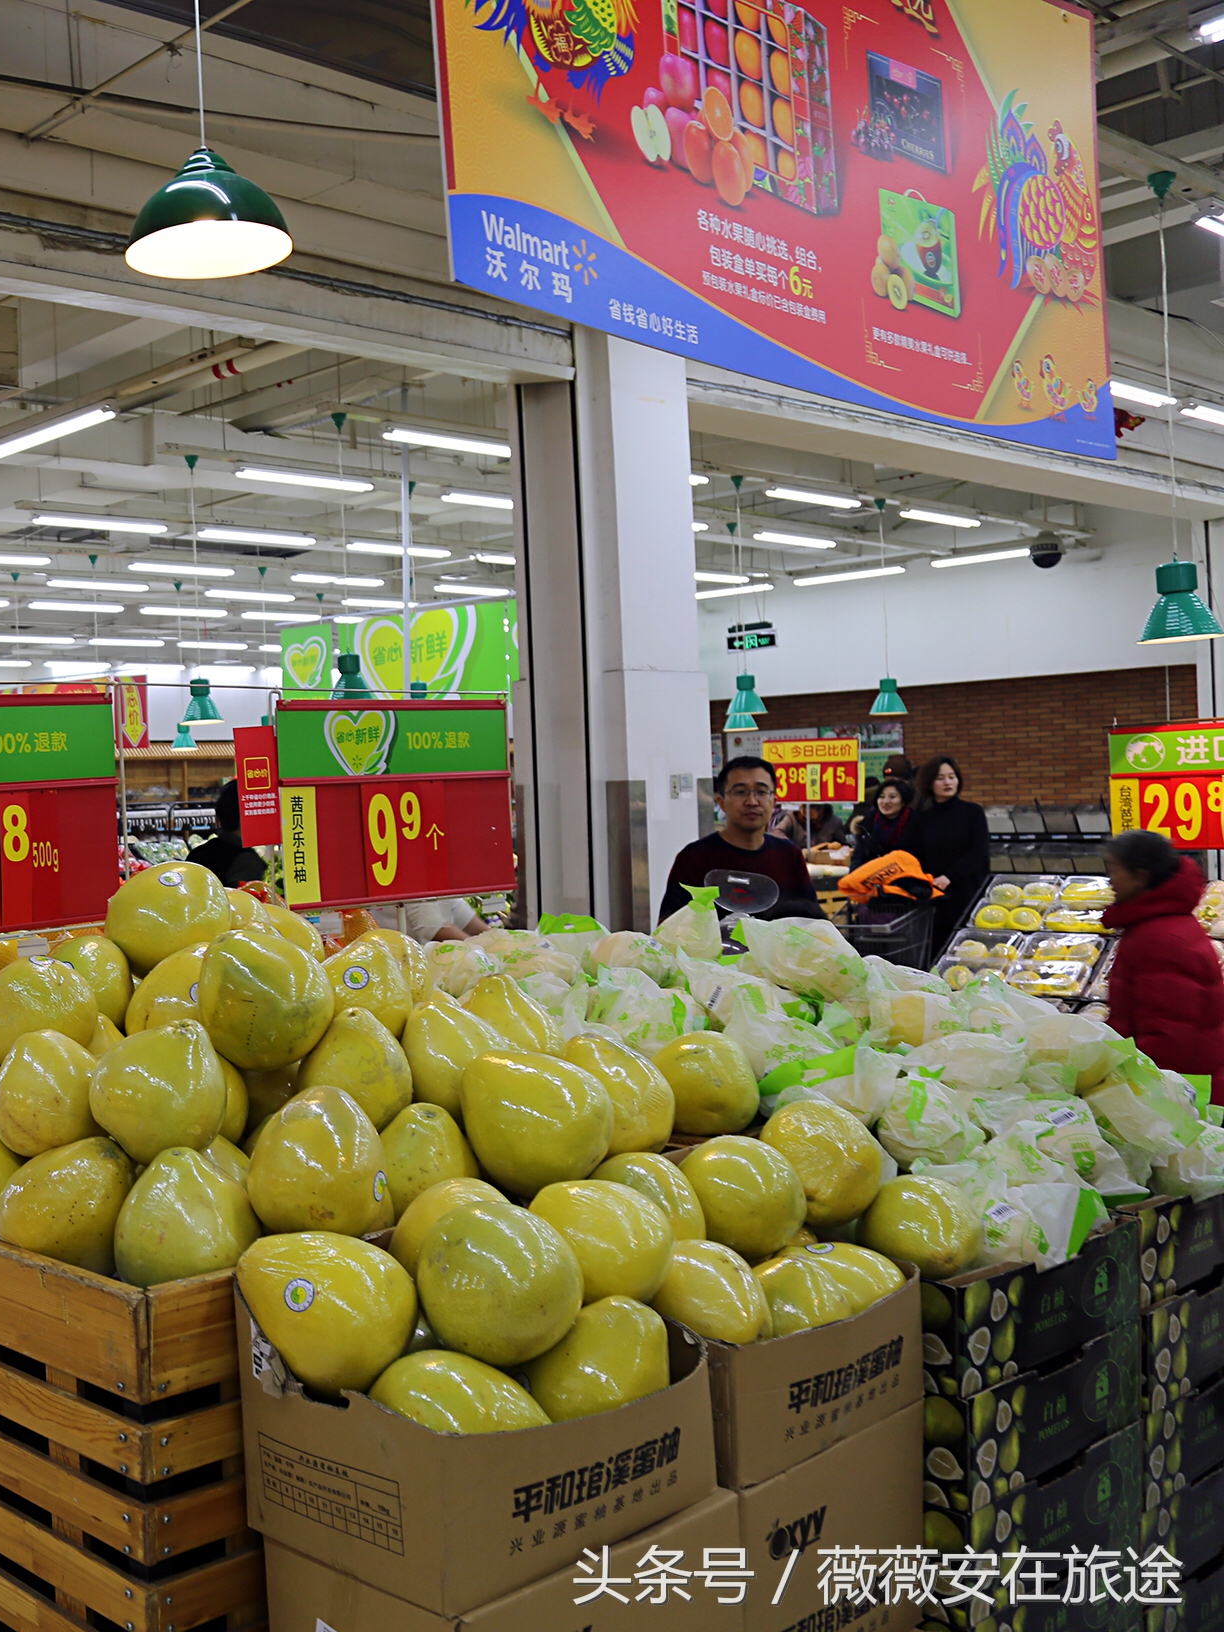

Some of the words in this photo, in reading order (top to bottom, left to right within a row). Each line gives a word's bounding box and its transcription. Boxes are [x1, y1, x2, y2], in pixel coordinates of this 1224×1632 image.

[481, 210, 571, 270] Walmart
[485, 247, 573, 304] 沃尔玛
[608, 298, 700, 345] 省钱省心好生活
[335, 726, 380, 745] 省心新鲜
[790, 743, 853, 758] 今日已比价
[32, 841, 59, 873] 500g
[290, 795, 307, 883] 茜贝乐白柚
[426, 823, 445, 851] 个
[788, 1334, 904, 1414] 平和琯溪蜜柚
[512, 1426, 681, 1523] 平和琯溪蜜柚
[509, 1469, 678, 1556] 兴业源蜜柚基地出品
